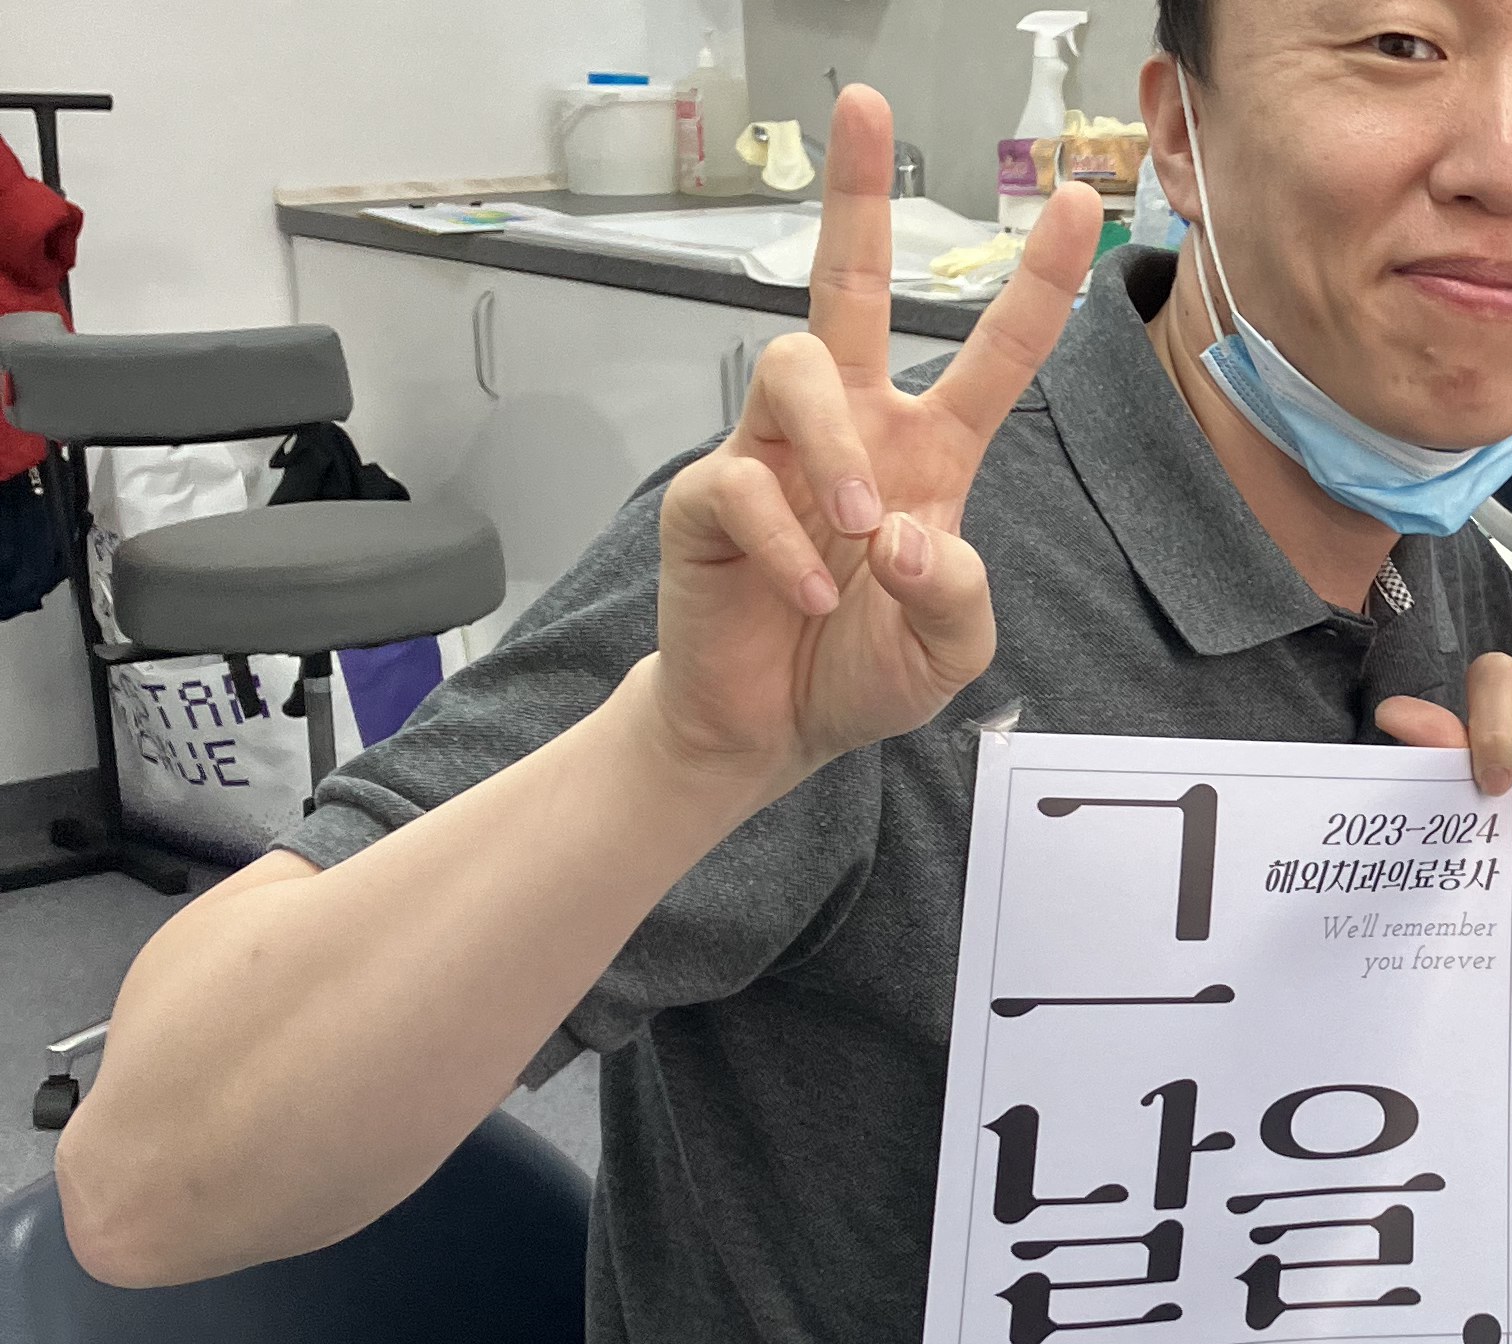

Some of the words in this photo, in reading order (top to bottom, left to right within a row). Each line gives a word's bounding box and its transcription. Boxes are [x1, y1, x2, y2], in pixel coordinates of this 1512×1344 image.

[1321, 812, 1500, 846] 2023-2024
[1265, 857, 1500, 894] 해외치과의료봉사
[988, 782, 1236, 1019] 그
[1323, 912, 1380, 940] We'll
[1379, 908, 1498, 939] remember
[1360, 956, 1404, 979] you
[1409, 943, 1497, 970] forever
